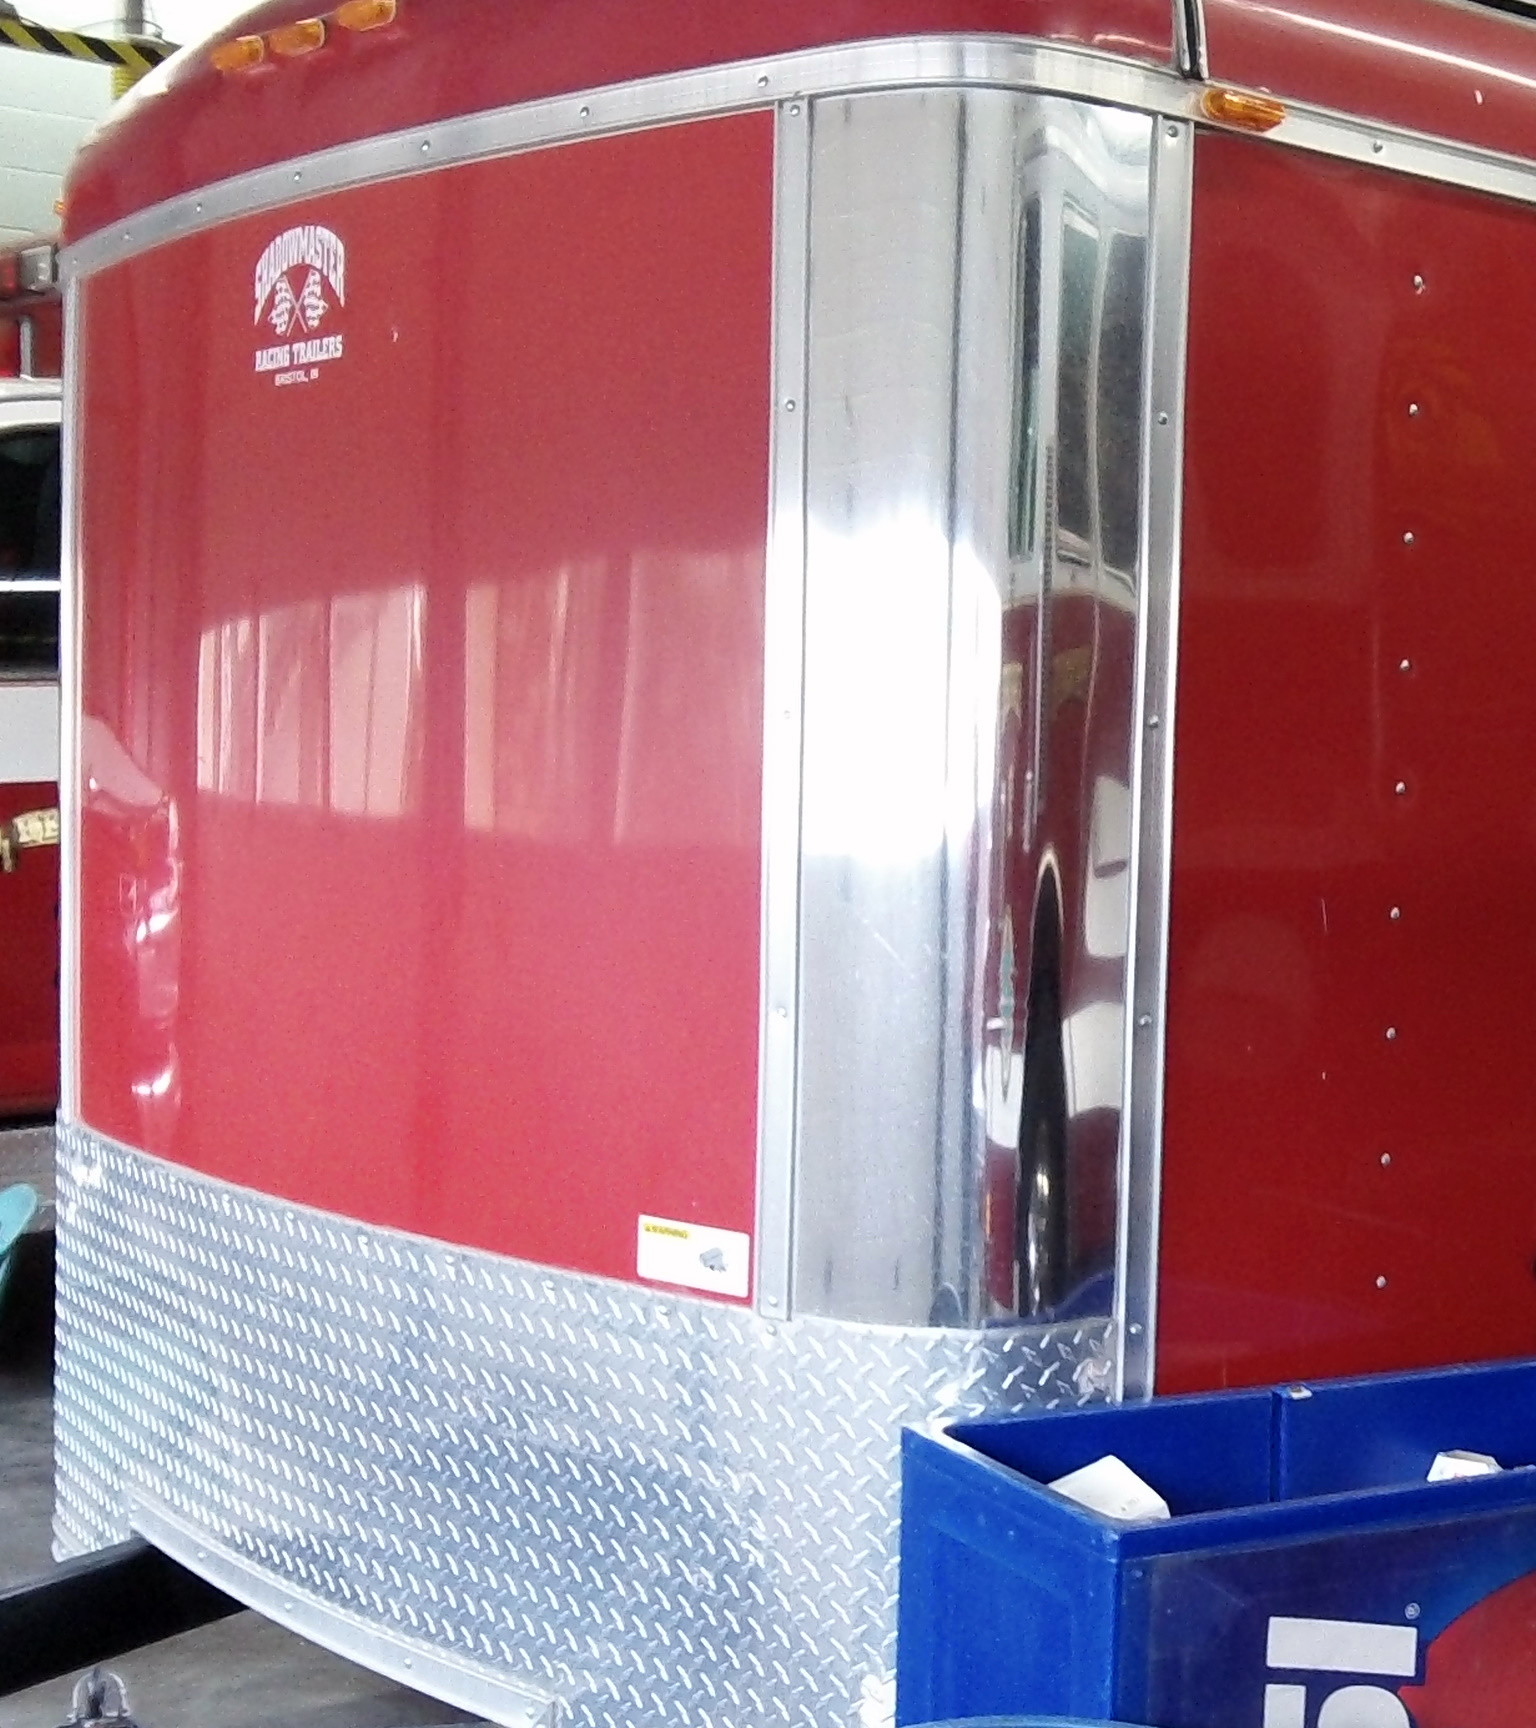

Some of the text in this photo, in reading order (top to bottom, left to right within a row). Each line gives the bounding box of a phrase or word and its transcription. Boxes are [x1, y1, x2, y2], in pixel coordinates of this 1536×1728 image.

[254, 225, 346, 326] SHADOWMASTER
[255, 334, 344, 372] RACING TRAILERS
